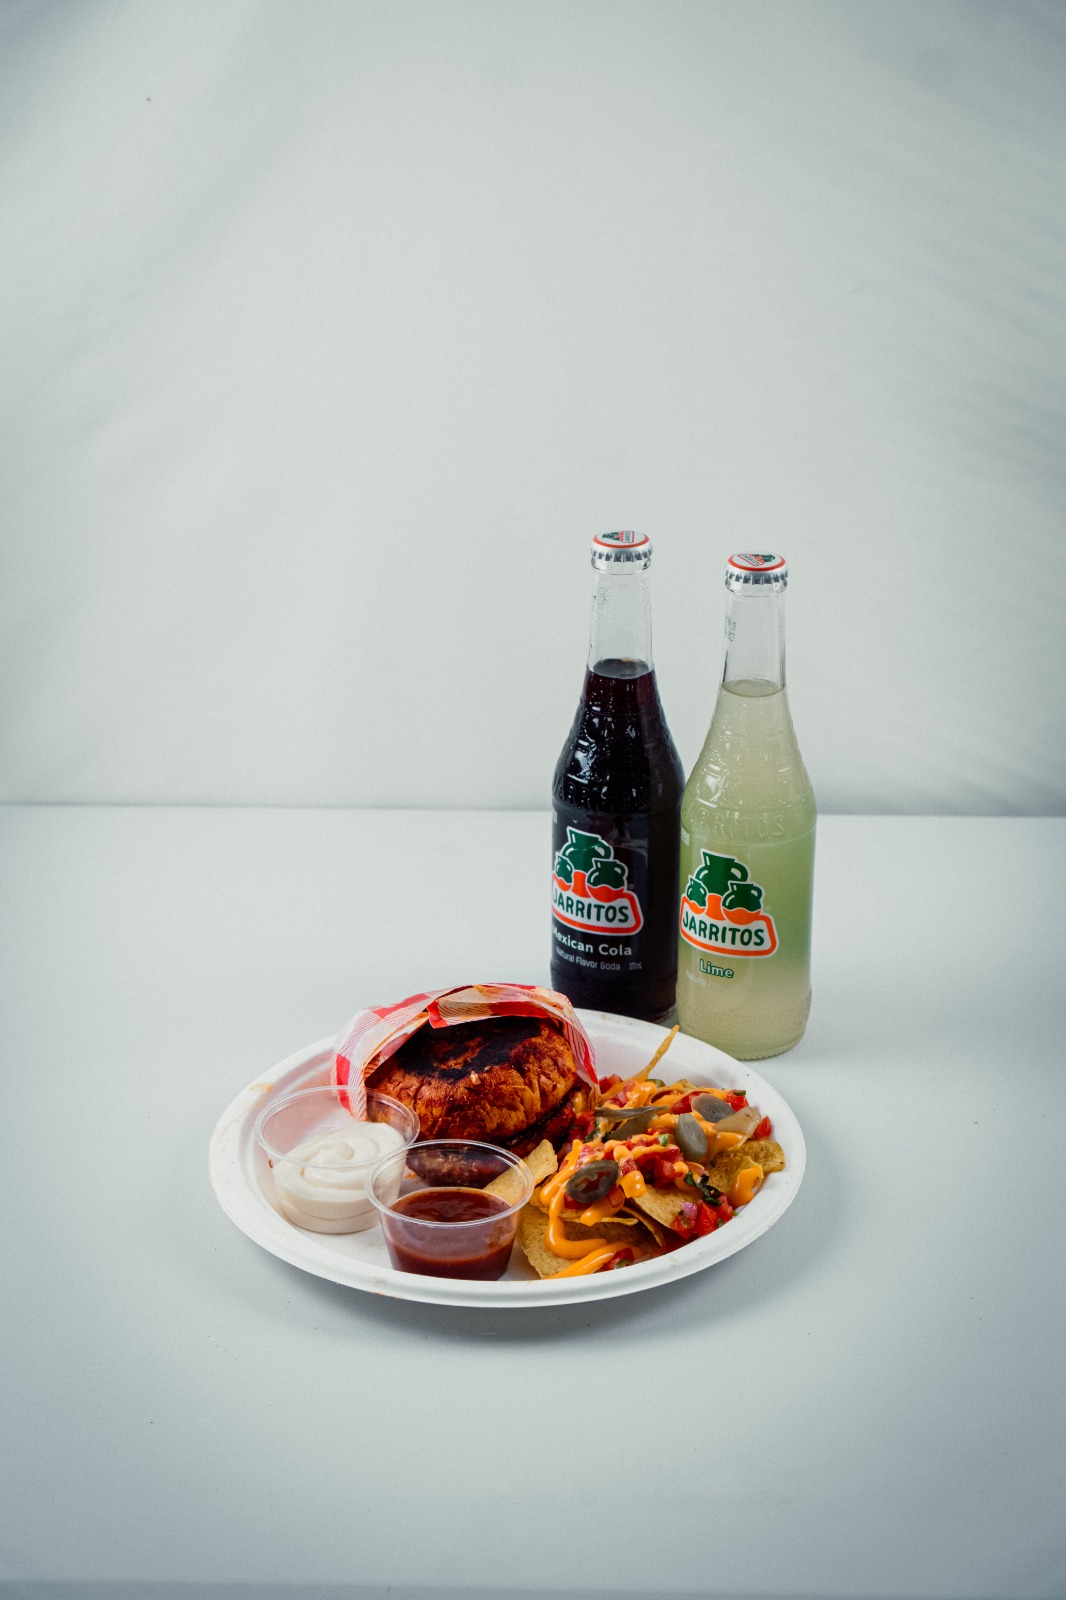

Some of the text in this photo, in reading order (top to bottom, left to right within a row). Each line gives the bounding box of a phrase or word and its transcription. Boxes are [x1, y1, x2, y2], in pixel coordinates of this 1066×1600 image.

[553, 888, 629, 924] JARRITOS
[553, 924, 632, 956] Mexican Cola
[682, 911, 765, 946] JARRITOS
[575, 956, 598, 969] Flavor
[599, 961, 621, 971] Soda
[699, 958, 734, 979] Lime
